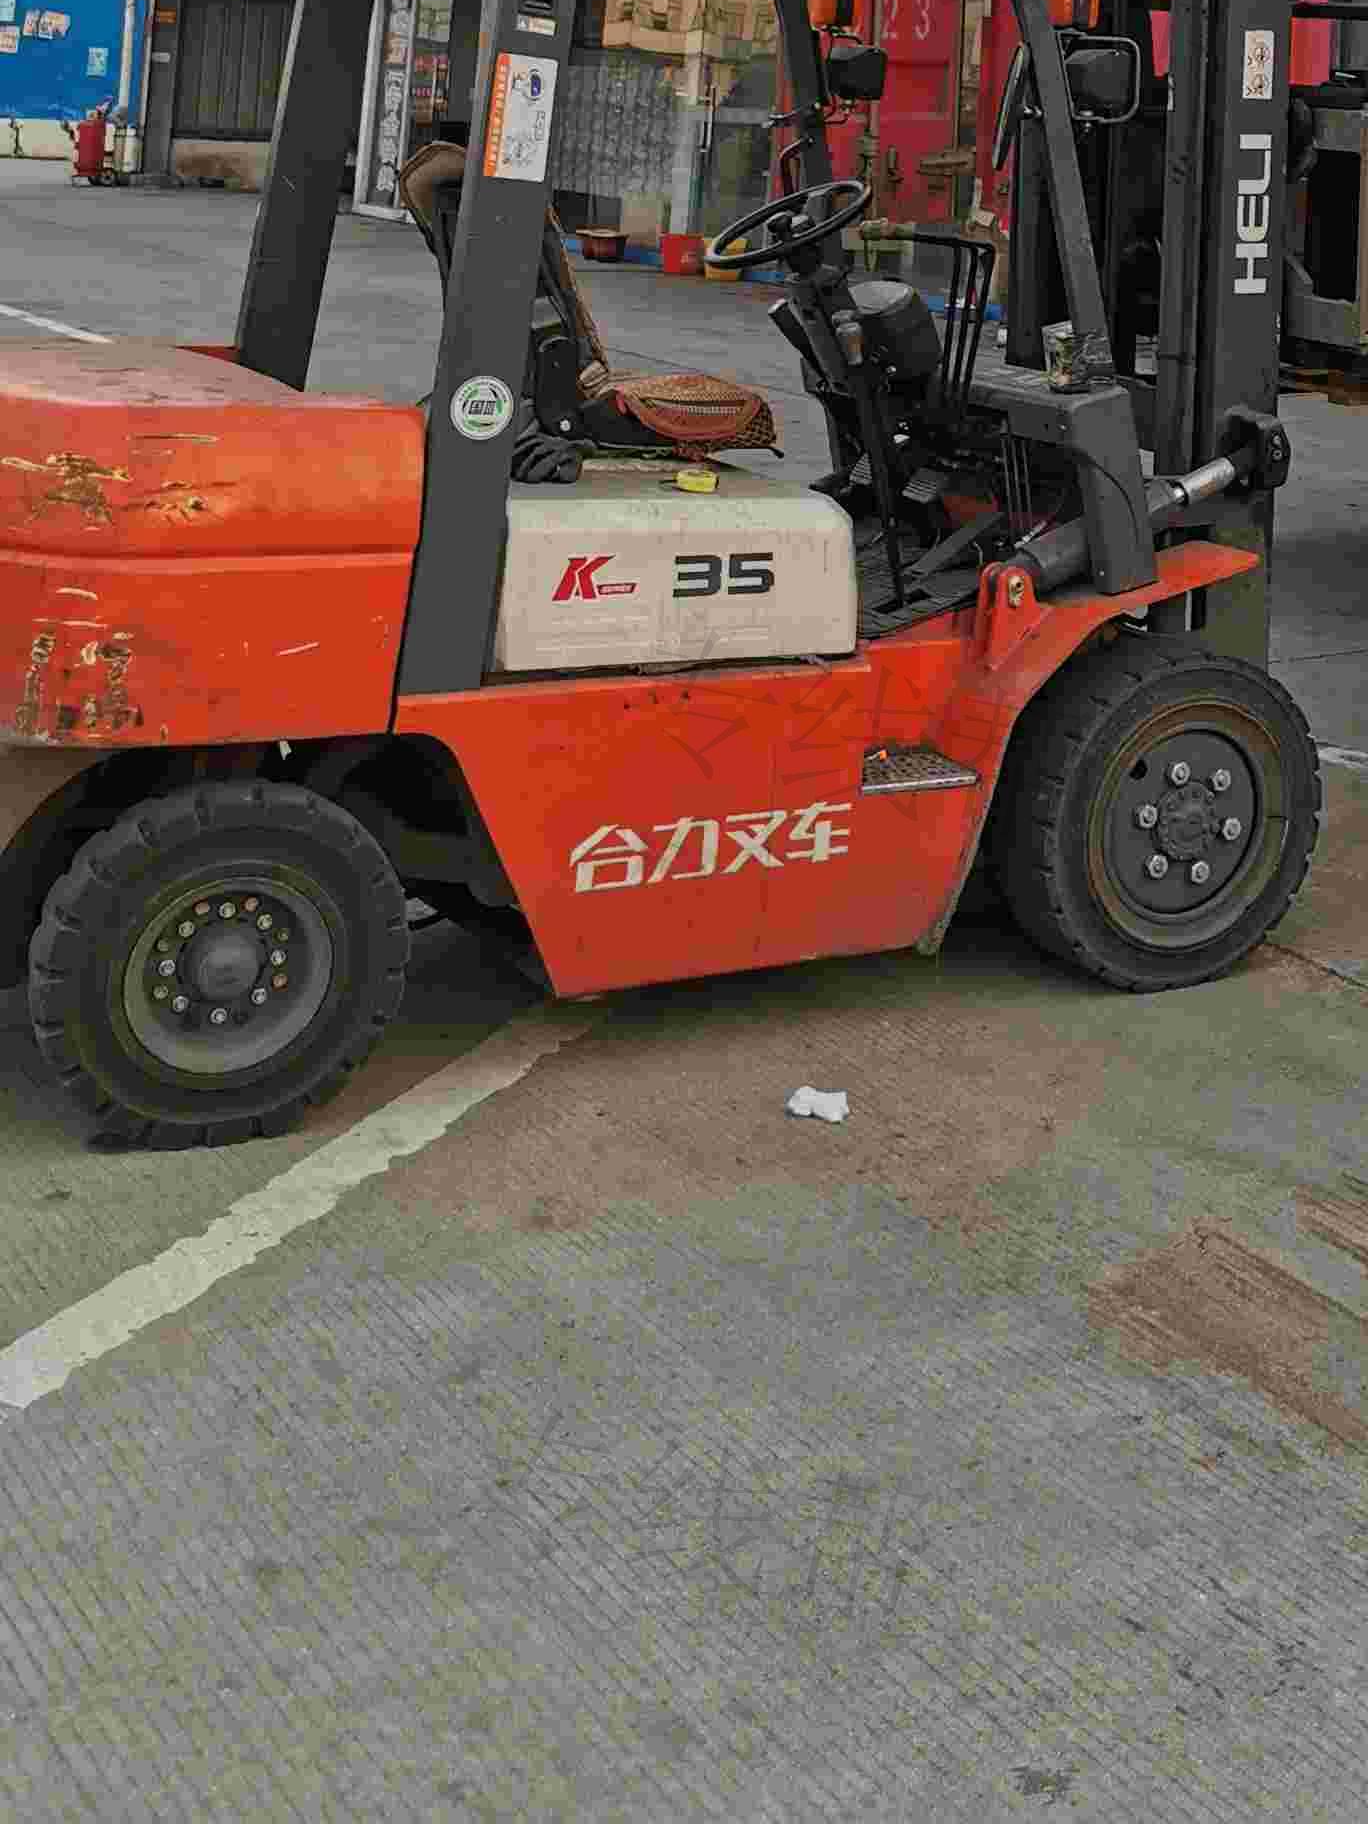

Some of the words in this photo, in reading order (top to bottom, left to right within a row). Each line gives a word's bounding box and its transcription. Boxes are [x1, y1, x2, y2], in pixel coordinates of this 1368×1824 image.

[1233, 133, 1272, 295] HELI
[552, 554, 617, 602] K
[673, 552, 775, 598] 35
[569, 801, 853, 894] 合力叉车
